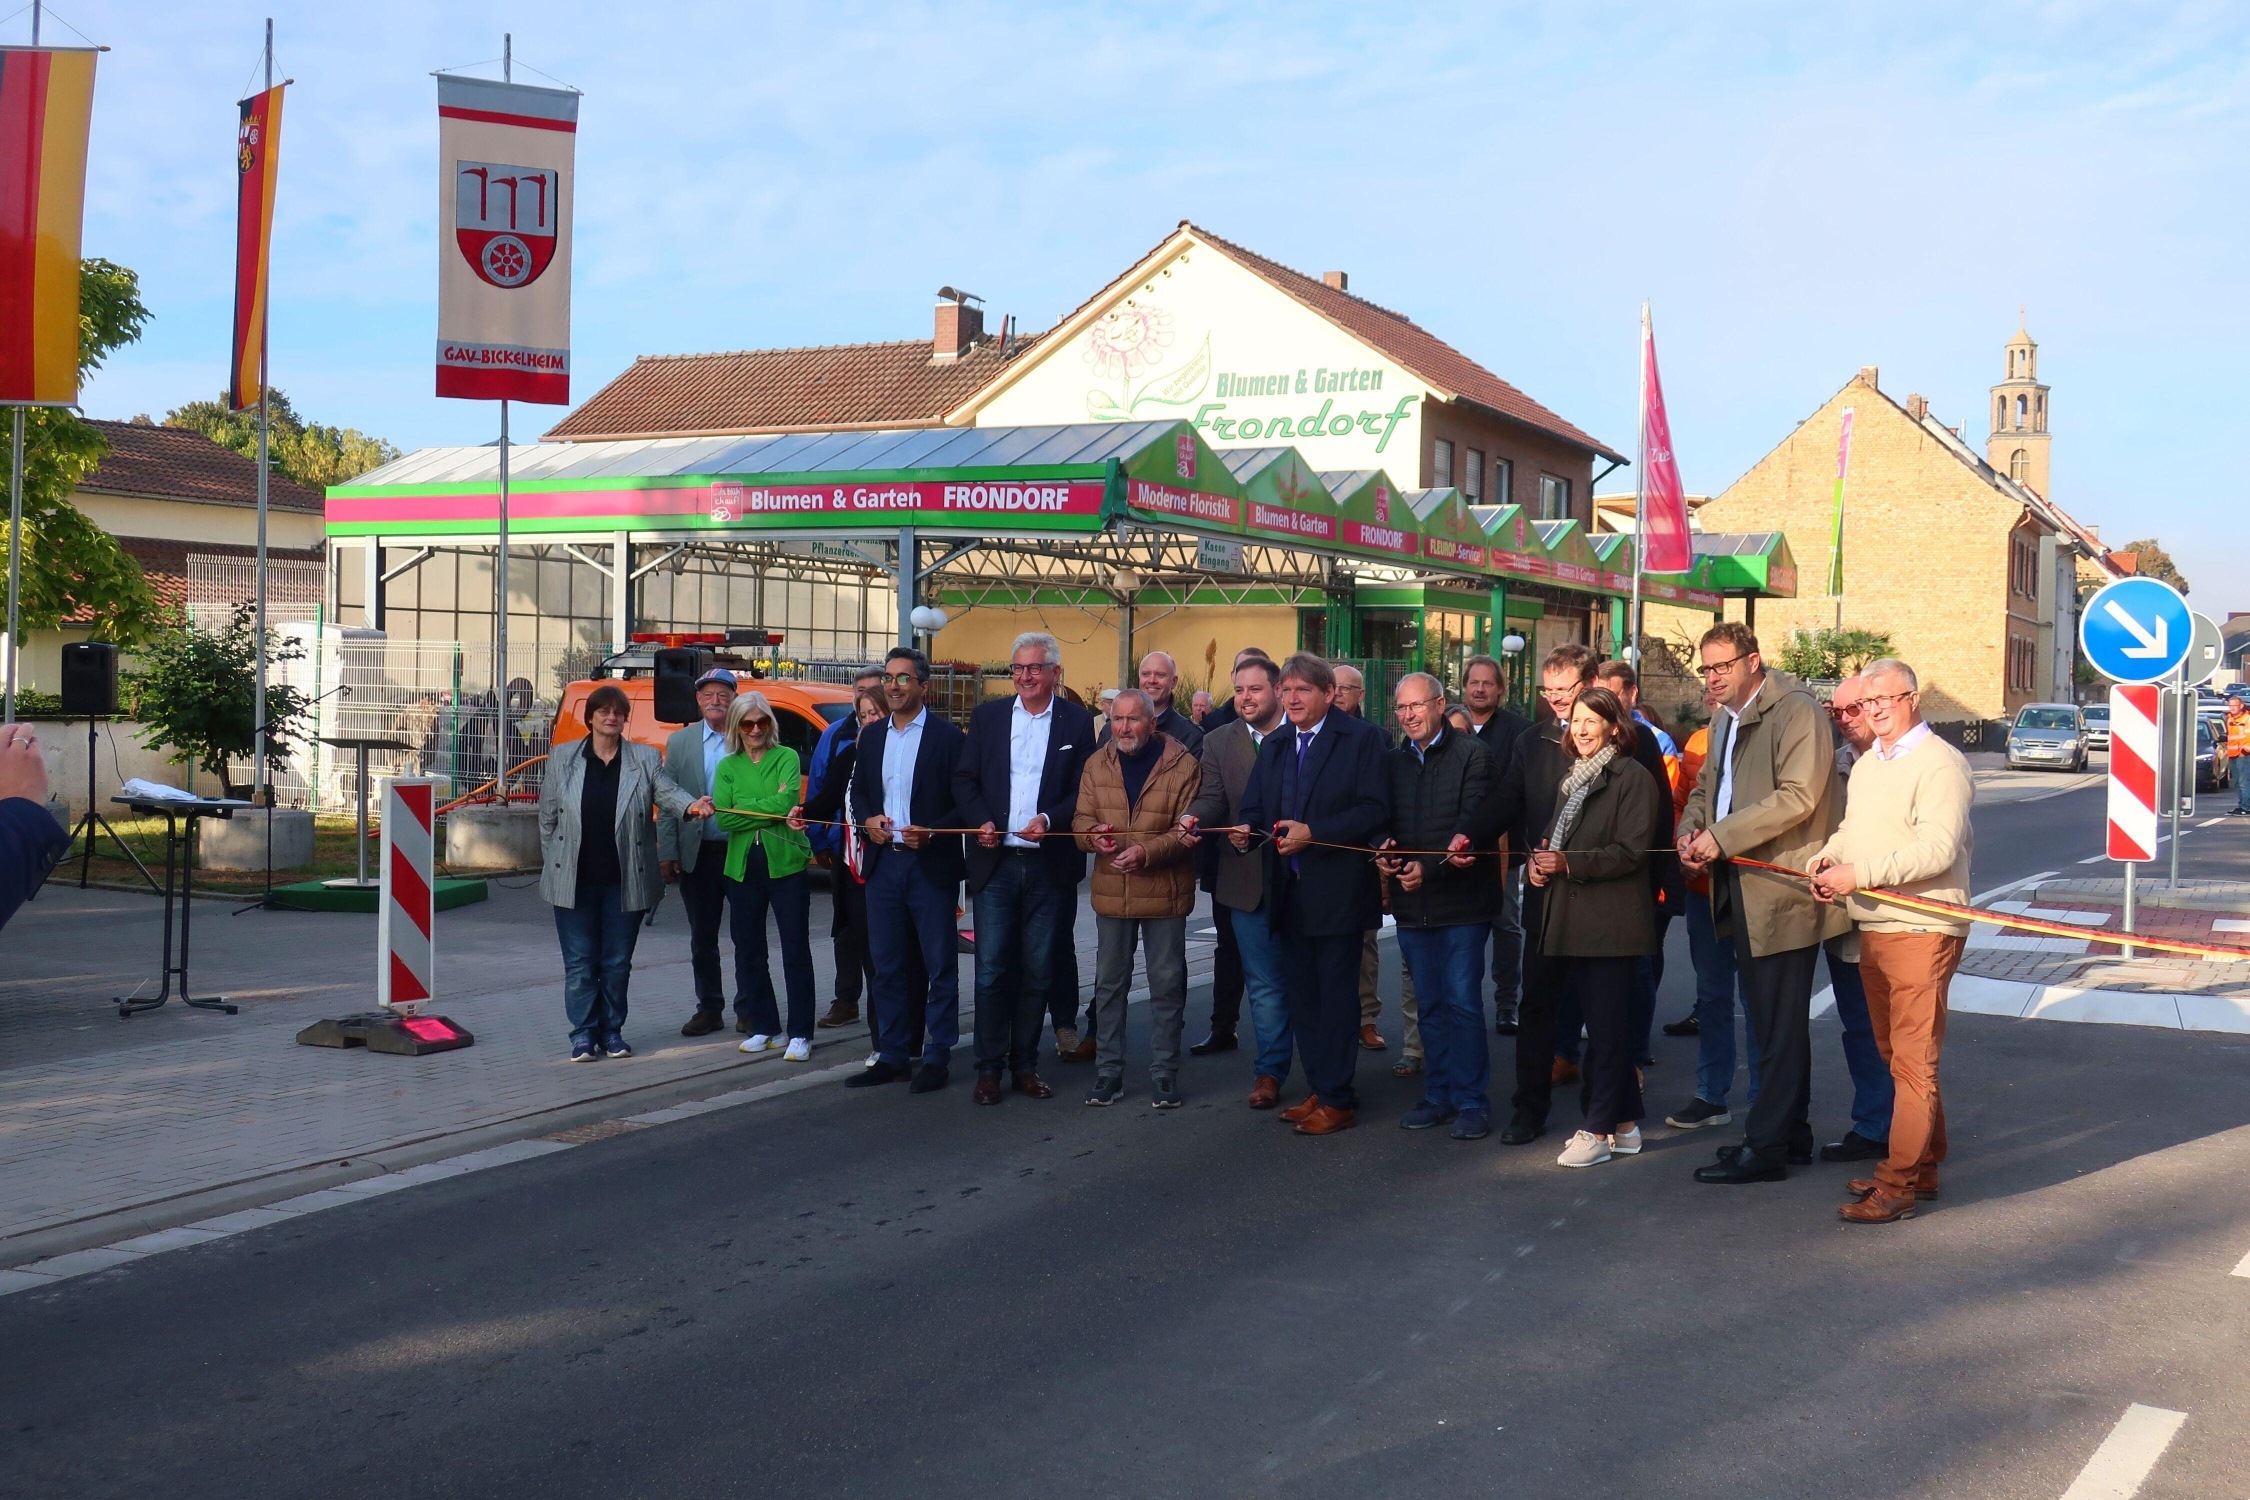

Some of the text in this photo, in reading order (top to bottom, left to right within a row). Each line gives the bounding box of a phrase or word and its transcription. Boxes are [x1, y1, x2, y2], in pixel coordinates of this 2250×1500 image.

[1216, 367, 1384, 398] Blumen & Garten
[1191, 395, 1421, 454] Frondorf
[751, 487, 922, 511] Blumen & Garten
[943, 486, 1069, 511] FRONDORF
[1138, 482, 1231, 519] Moderne Floristik
[1255, 505, 1328, 535] Blumen & Garten
[1204, 540, 1226, 554] Kasse
[1360, 525, 1403, 549] FRONDORF
[1200, 553, 1230, 568] Eingang
